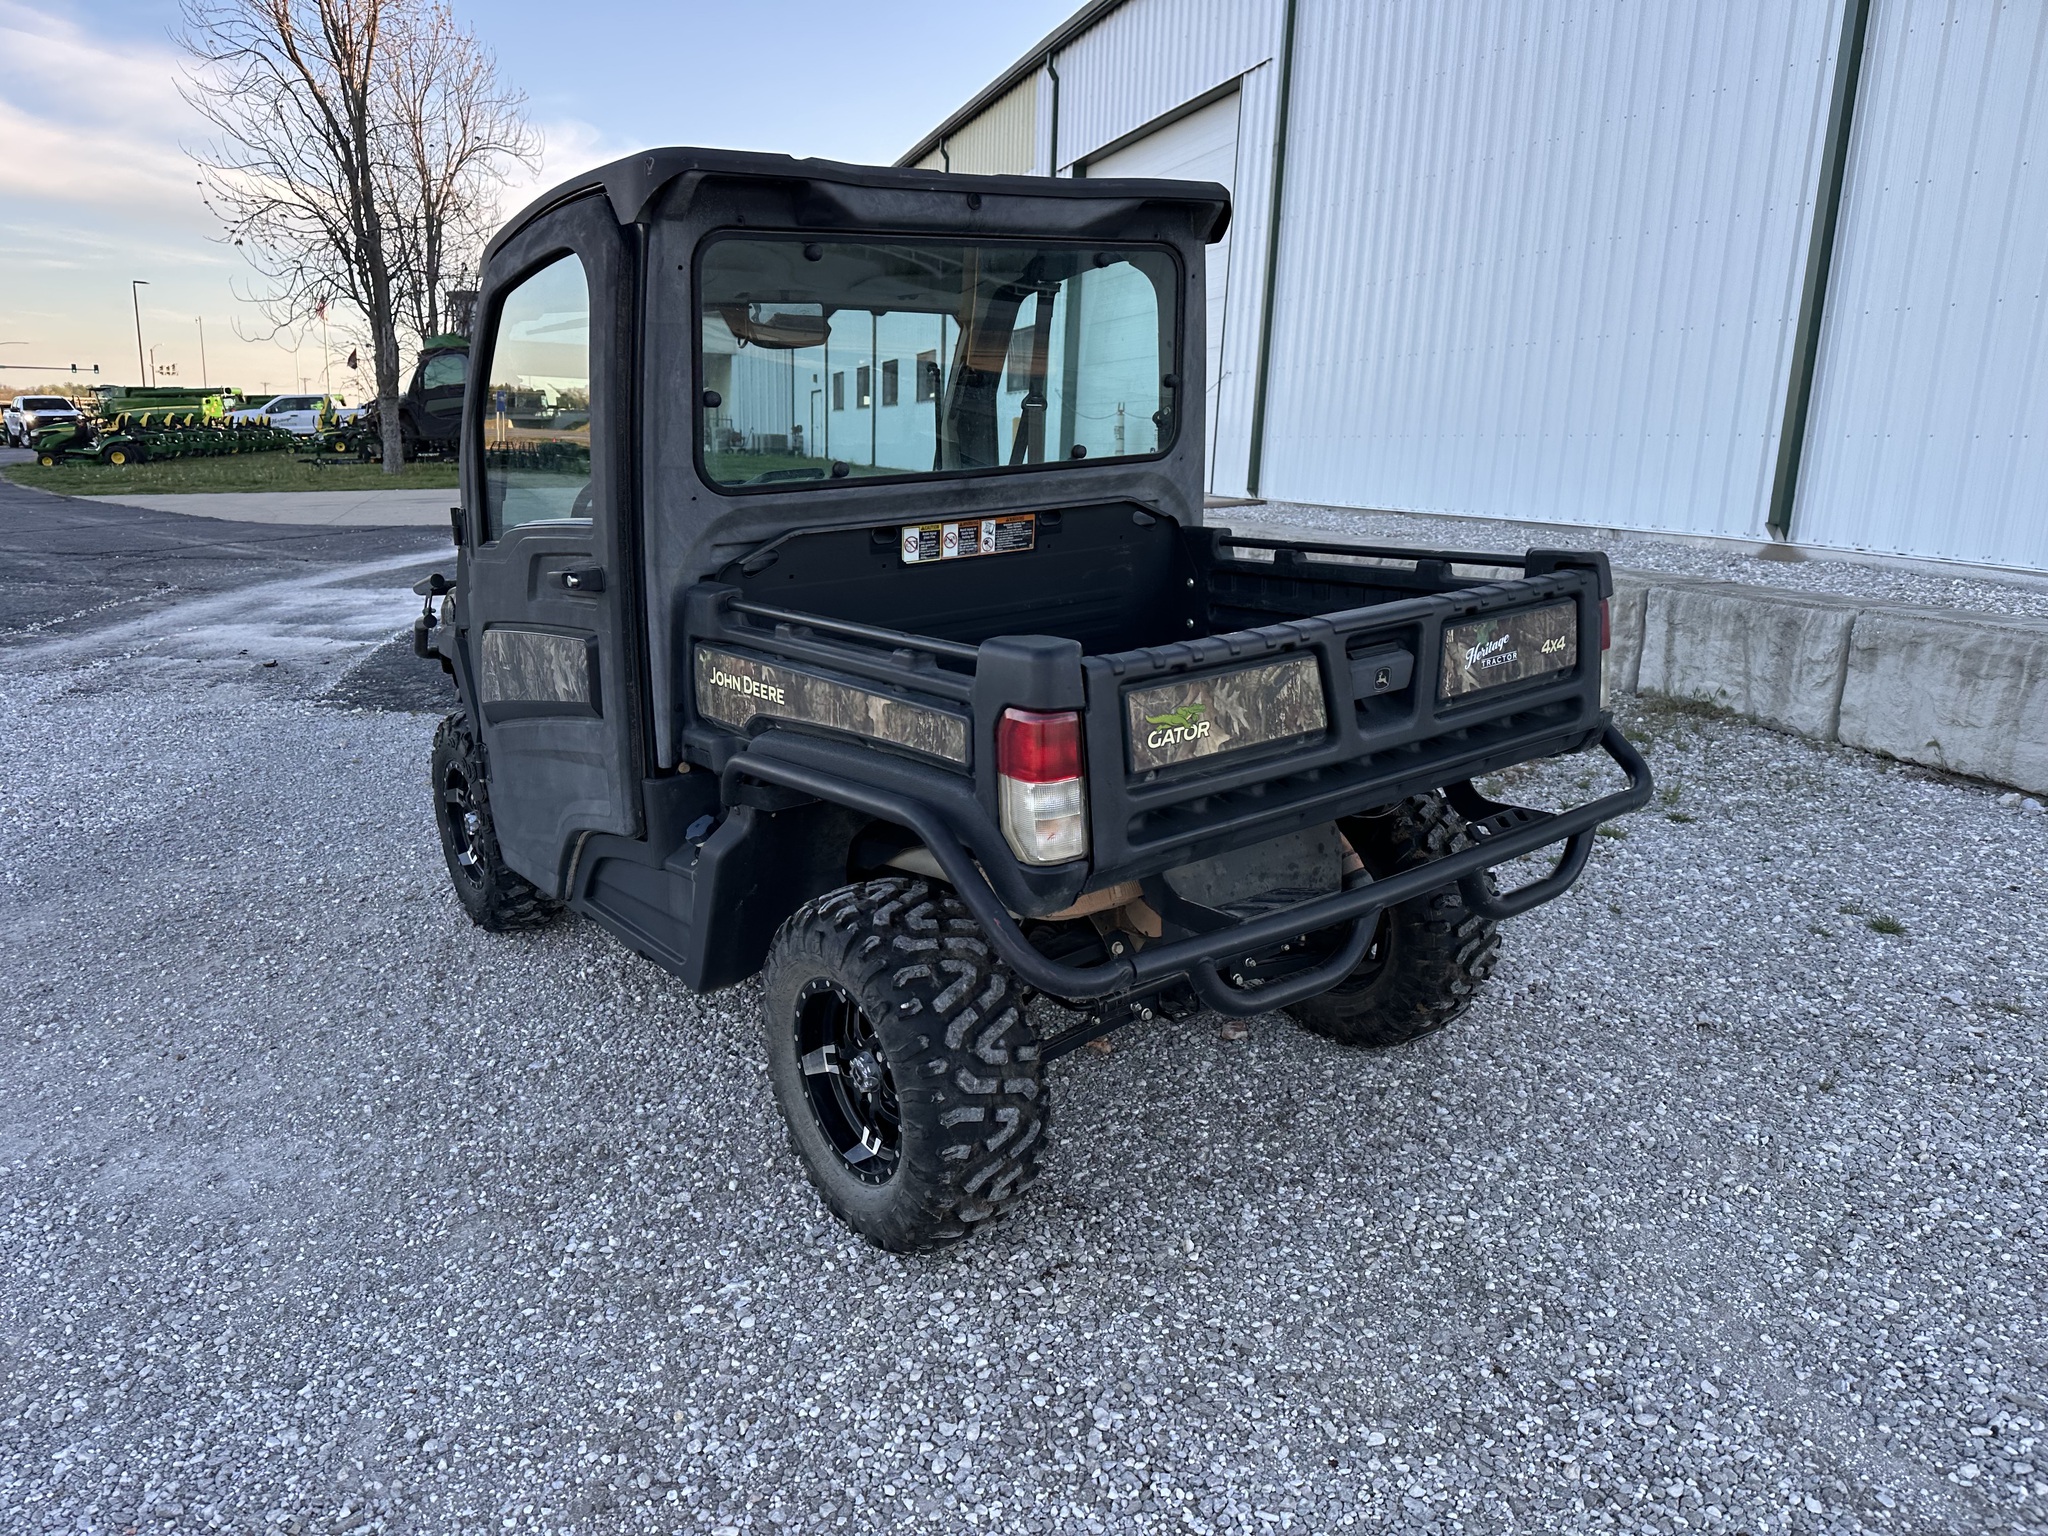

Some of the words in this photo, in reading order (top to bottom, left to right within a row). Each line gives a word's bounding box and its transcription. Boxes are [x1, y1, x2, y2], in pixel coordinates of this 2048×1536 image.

[1464, 634, 1510, 669] Heritage
[1481, 651, 1518, 667] TRACTOR
[710, 667, 740, 691] JOHN
[743, 675, 785, 705] DEERE
[1147, 721, 1210, 748] GATOR
